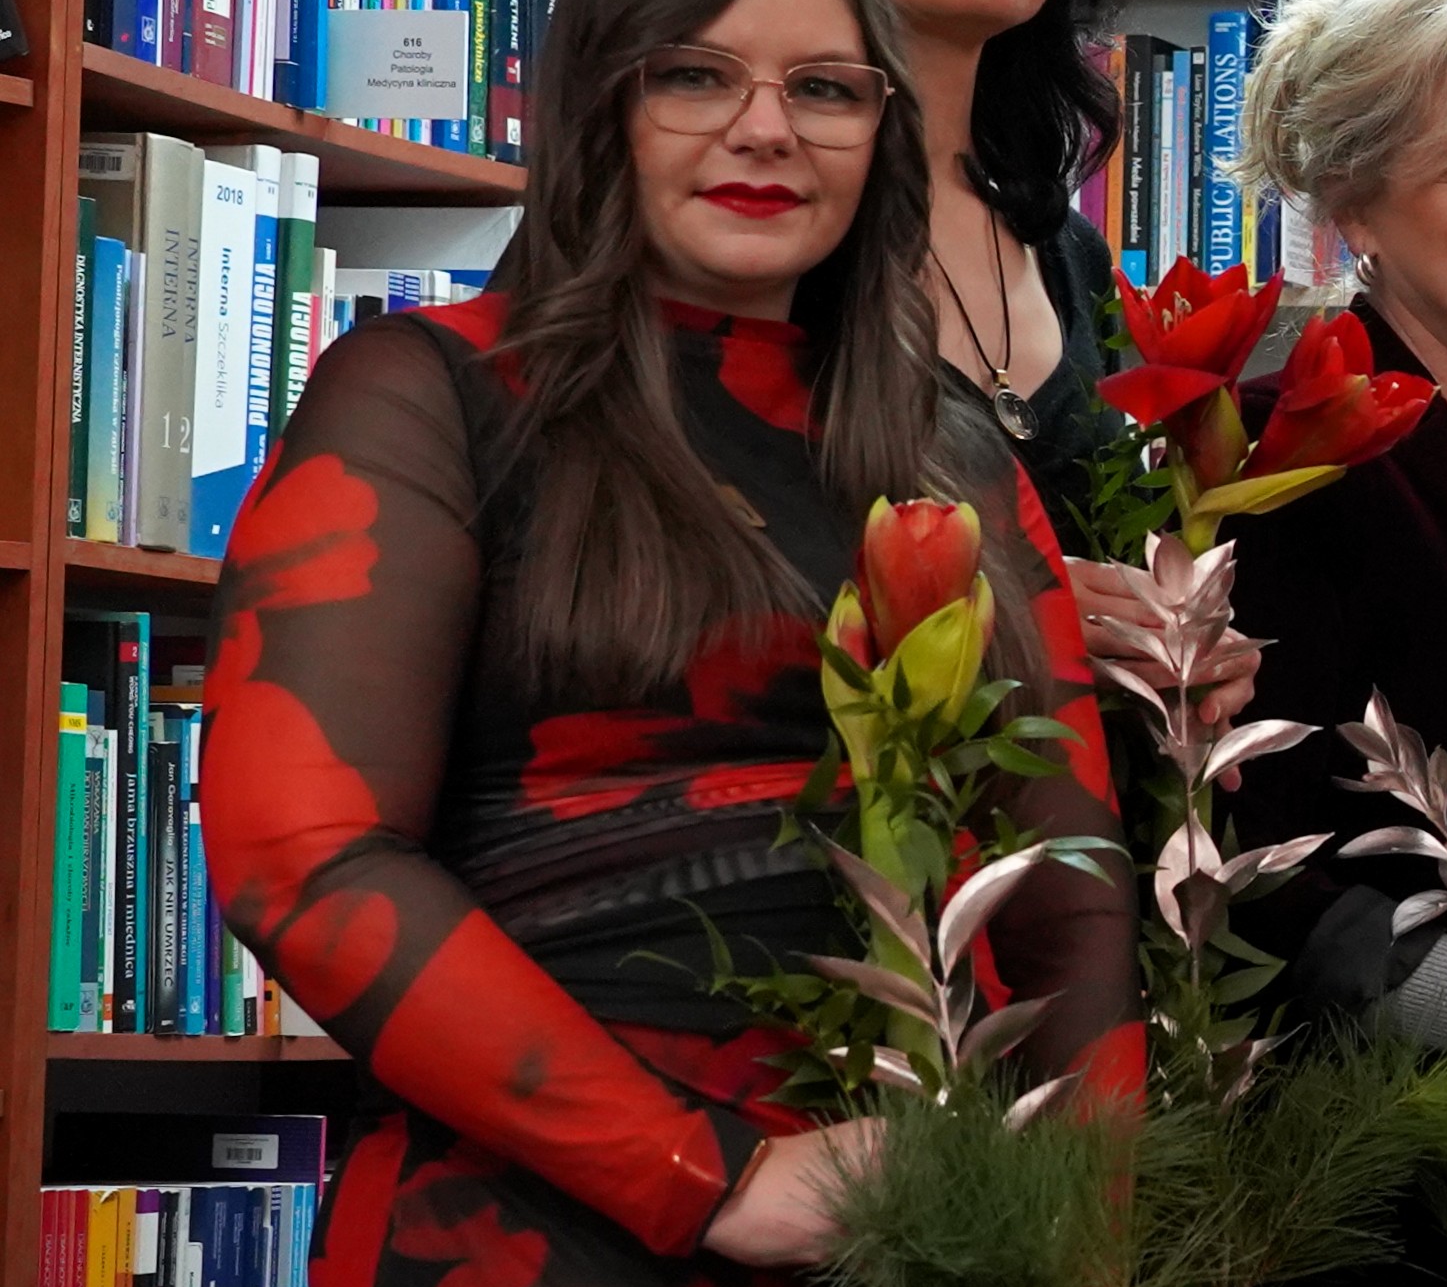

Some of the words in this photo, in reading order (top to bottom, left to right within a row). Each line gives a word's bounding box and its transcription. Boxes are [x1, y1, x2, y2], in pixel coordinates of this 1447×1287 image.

[393, 50, 432, 61] Choroby
[403, 38, 421, 47] 616
[367, 77, 414, 90] Medycyna
[417, 78, 457, 88] kliniczna
[391, 63, 433, 76] Patologia
[1131, 156, 1144, 189] Media
[216, 185, 244, 206] 2018
[1129, 189, 1143, 244] powszednie
[161, 228, 180, 341] INTERNA
[183, 236, 199, 345] INTERNA
[219, 247, 233, 317] Interna
[215, 318, 229, 410] Szczeklika
[248, 262, 276, 427] PULMONOLOGIA
[160, 411, 171, 450] 1
[179, 416, 191, 455] 2
[125, 772, 137, 814] Jama
[126, 817, 136, 881] brzuszna
[166, 855, 175, 886] JAK
[166, 890, 175, 914] NIE
[124, 893, 136, 979] miednica
